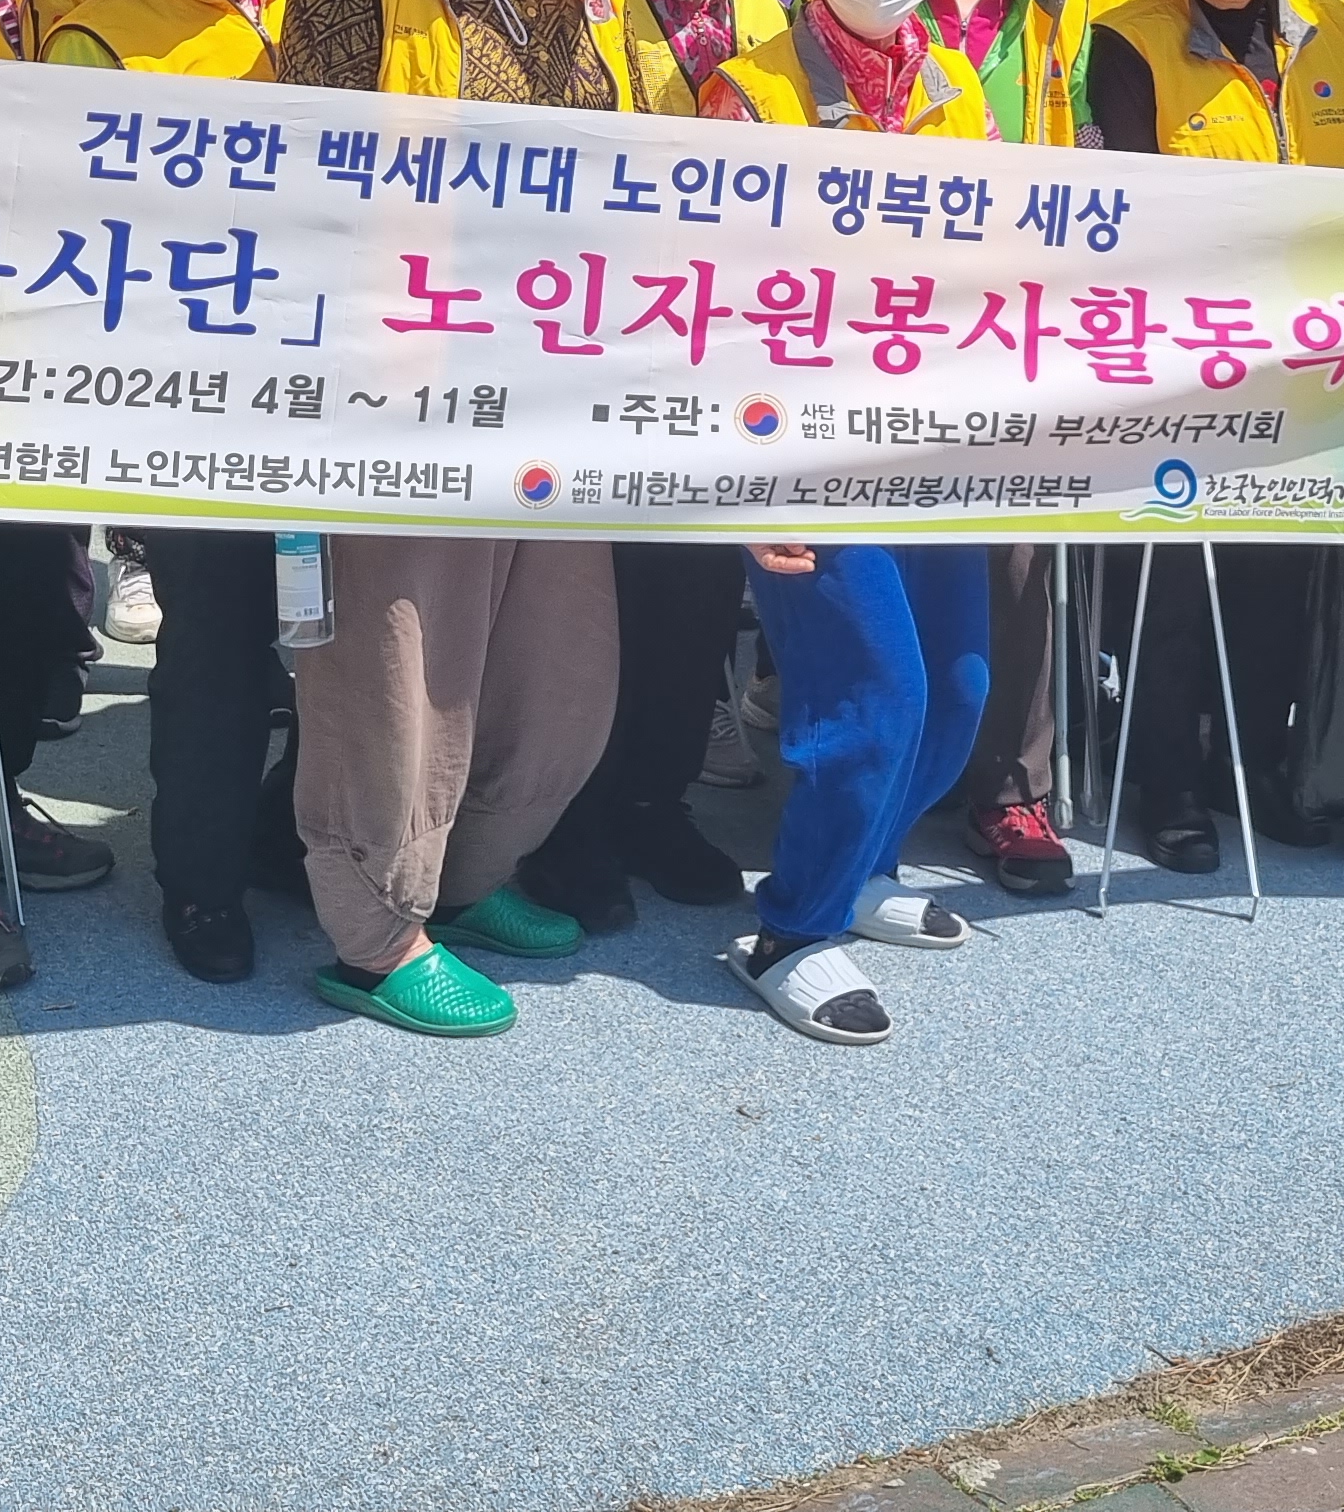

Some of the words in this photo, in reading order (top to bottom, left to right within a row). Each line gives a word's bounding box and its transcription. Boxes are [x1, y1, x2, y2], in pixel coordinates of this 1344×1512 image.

[78, 110, 288, 191] 건강한
[317, 129, 578, 213] 백세시대
[602, 153, 789, 228] 노인이
[816, 165, 994, 242] 행복한
[1015, 183, 1131, 253] 세상
[250, 372, 326, 420] 4월
[413, 384, 510, 429] 11월
[619, 393, 720, 437] 주관:
[800, 403, 836, 421] 사단
[801, 422, 836, 440] 법인
[847, 406, 1038, 448] 대한노인회
[1047, 409, 1284, 447] 부산강서구지회
[105, 449, 474, 502] 노인자원봉사지원센터
[571, 468, 604, 486] 사단
[611, 470, 779, 507] 대한노인회
[785, 473, 1094, 509] 노인자원봉사지원본부
[570, 487, 603, 505] 법인
[1205, 508, 1227, 517] Korea
[1228, 508, 1250, 517] Labor
[1252, 508, 1273, 518] Force
[1274, 508, 1327, 520] Development
